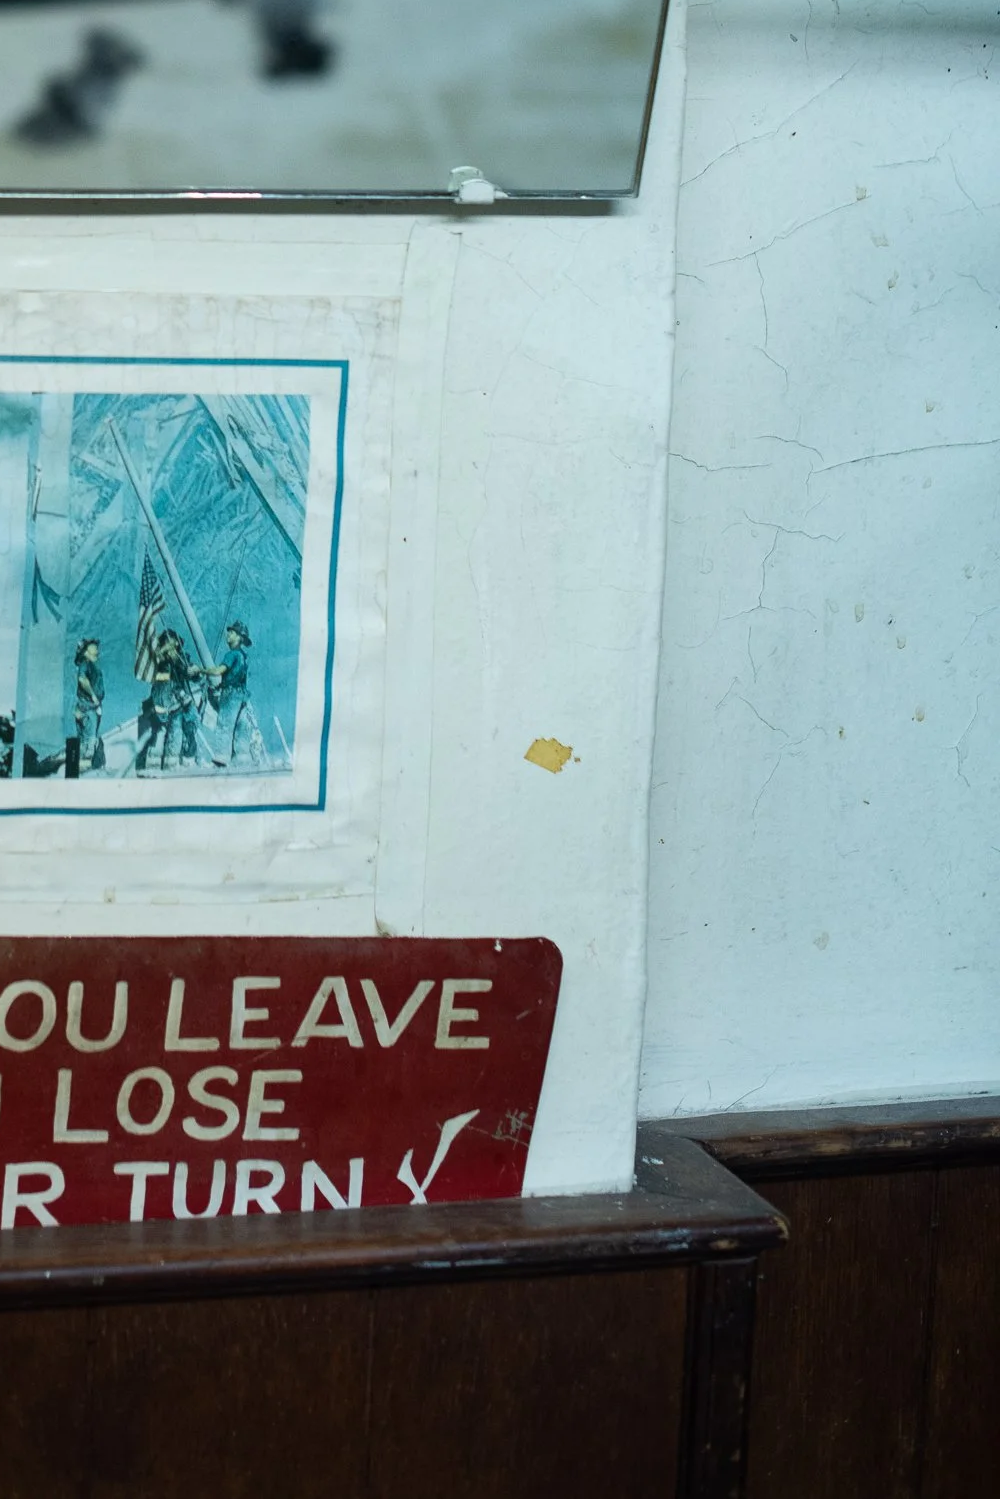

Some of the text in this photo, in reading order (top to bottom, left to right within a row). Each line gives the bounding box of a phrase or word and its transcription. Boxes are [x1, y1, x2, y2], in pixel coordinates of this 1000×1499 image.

[164, 976, 493, 1052] LEAVE
[53, 1066, 303, 1143] LOSE
[113, 1157, 365, 1223] TURN
